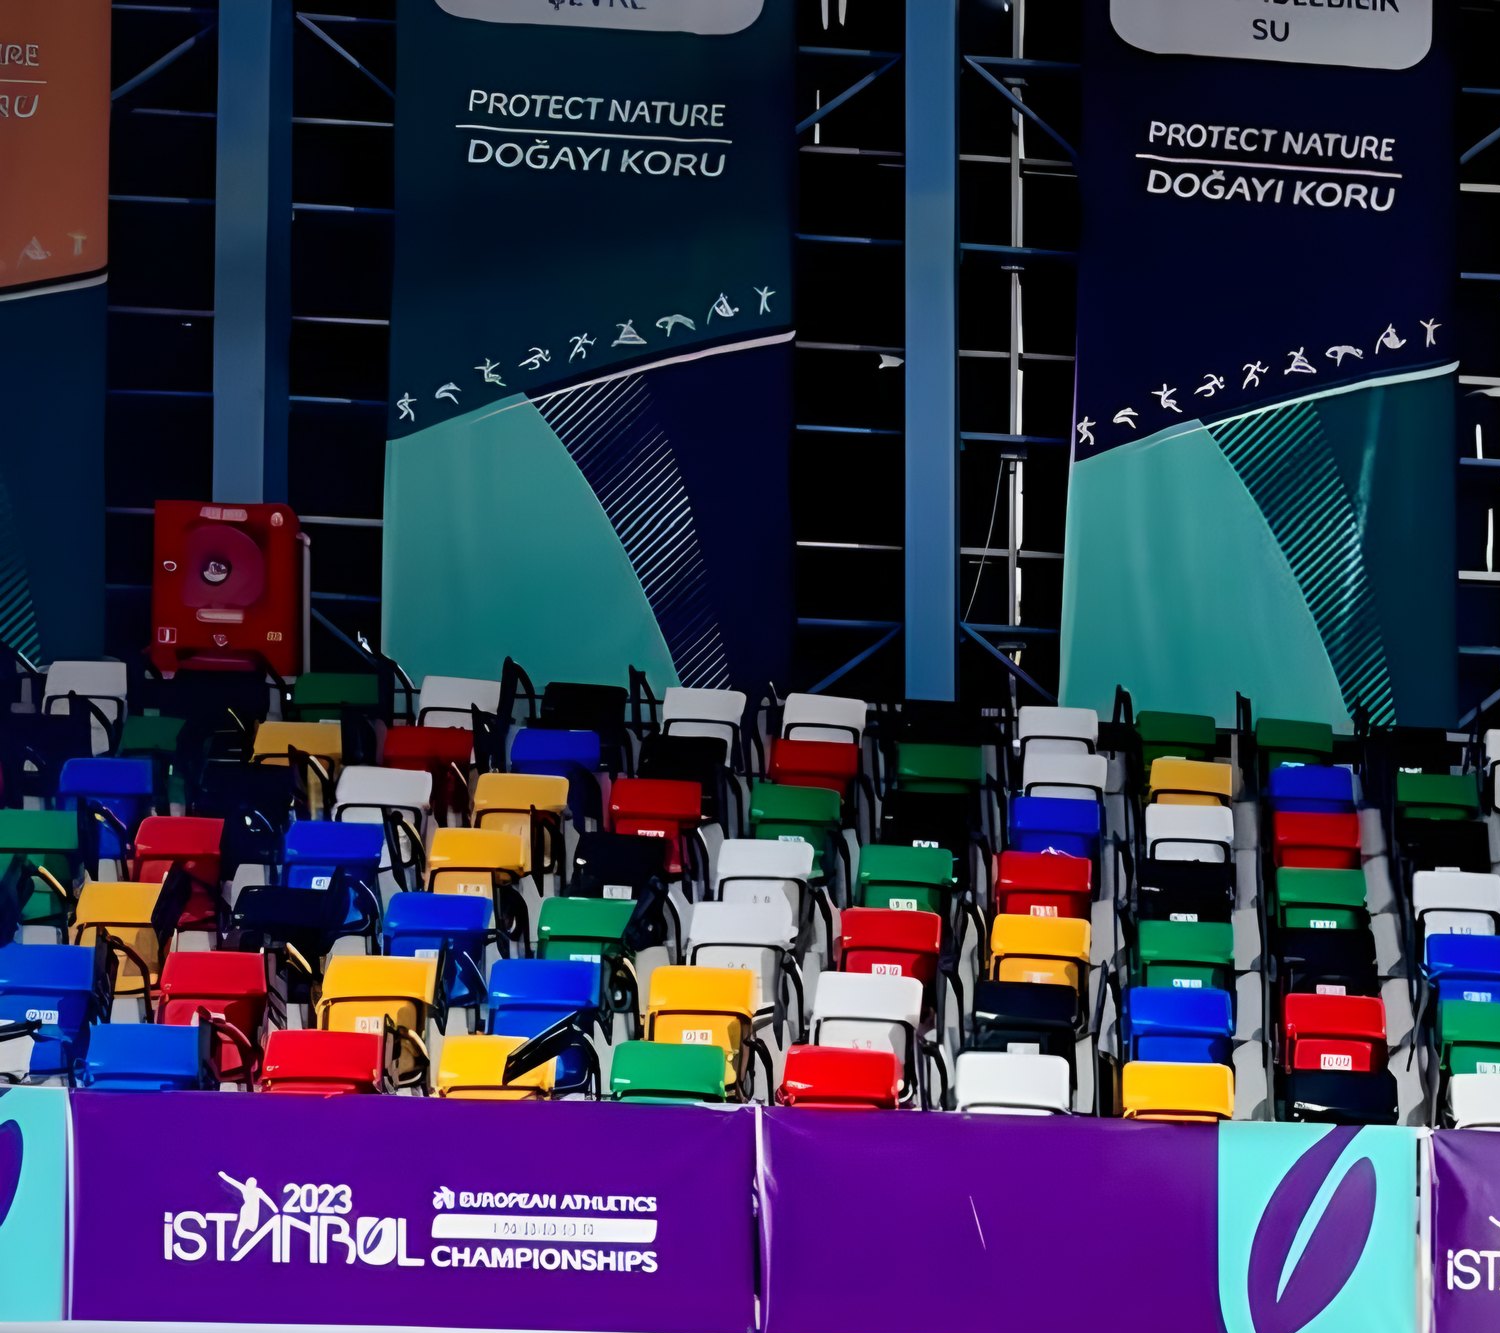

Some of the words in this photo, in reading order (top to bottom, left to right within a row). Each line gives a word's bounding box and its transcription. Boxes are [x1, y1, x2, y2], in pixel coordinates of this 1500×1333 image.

[1252, 18, 1290, 42] SU
[469, 89, 604, 120] PROTECT
[608, 99, 726, 127] NATURE
[467, 139, 610, 172] DOĞAYI
[620, 150, 726, 176] KORU
[1149, 120, 1277, 154] PROTECT
[1282, 131, 1396, 162] NATURE
[1147, 169, 1283, 203] DOĞAYI
[1293, 180, 1396, 212] KORU
[283, 1183, 352, 1214] 2023
[431, 1245, 658, 1273] CHAMPIONSHIPS
